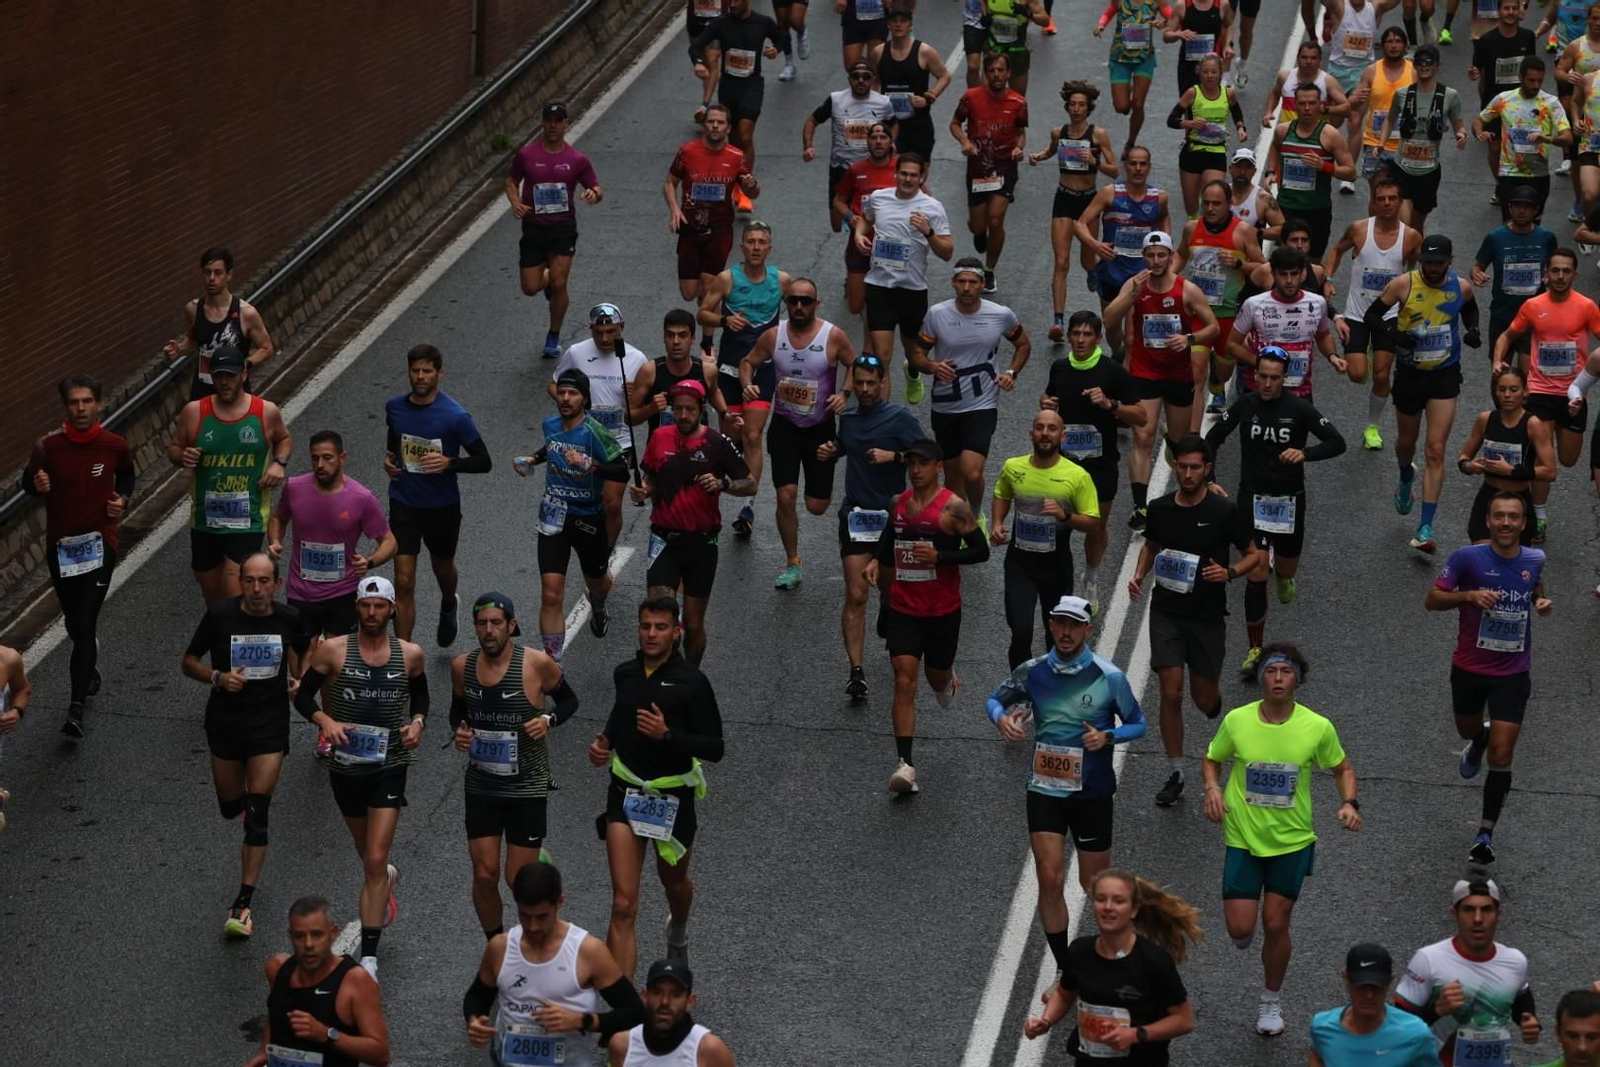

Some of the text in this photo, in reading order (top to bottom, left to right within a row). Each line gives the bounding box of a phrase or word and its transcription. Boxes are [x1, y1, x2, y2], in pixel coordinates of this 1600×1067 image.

[696, 184, 718, 196] 2162
[1148, 322, 1172, 334] 2238
[1541, 350, 1567, 362] 2694
[783, 388, 808, 401] 4759
[1066, 432, 1092, 446] 2980
[1250, 424, 1291, 443] PAS
[202, 453, 255, 467] BIKILA
[855, 514, 882, 526] 2652
[65, 543, 93, 558] 2299
[307, 552, 334, 565] 1523
[1160, 558, 1186, 575] 2648
[1487, 620, 1519, 634] 2758
[239, 646, 272, 661] 2705
[474, 710, 522, 723] abelenda
[350, 736, 375, 751] 912
[475, 740, 505, 756] 2797
[1040, 755, 1071, 772] 3620
[1252, 771, 1286, 789] 2359
[631, 799, 666, 819] 2283
[511, 1038, 550, 1057] 2808
[1465, 1044, 1501, 1061] 2399
